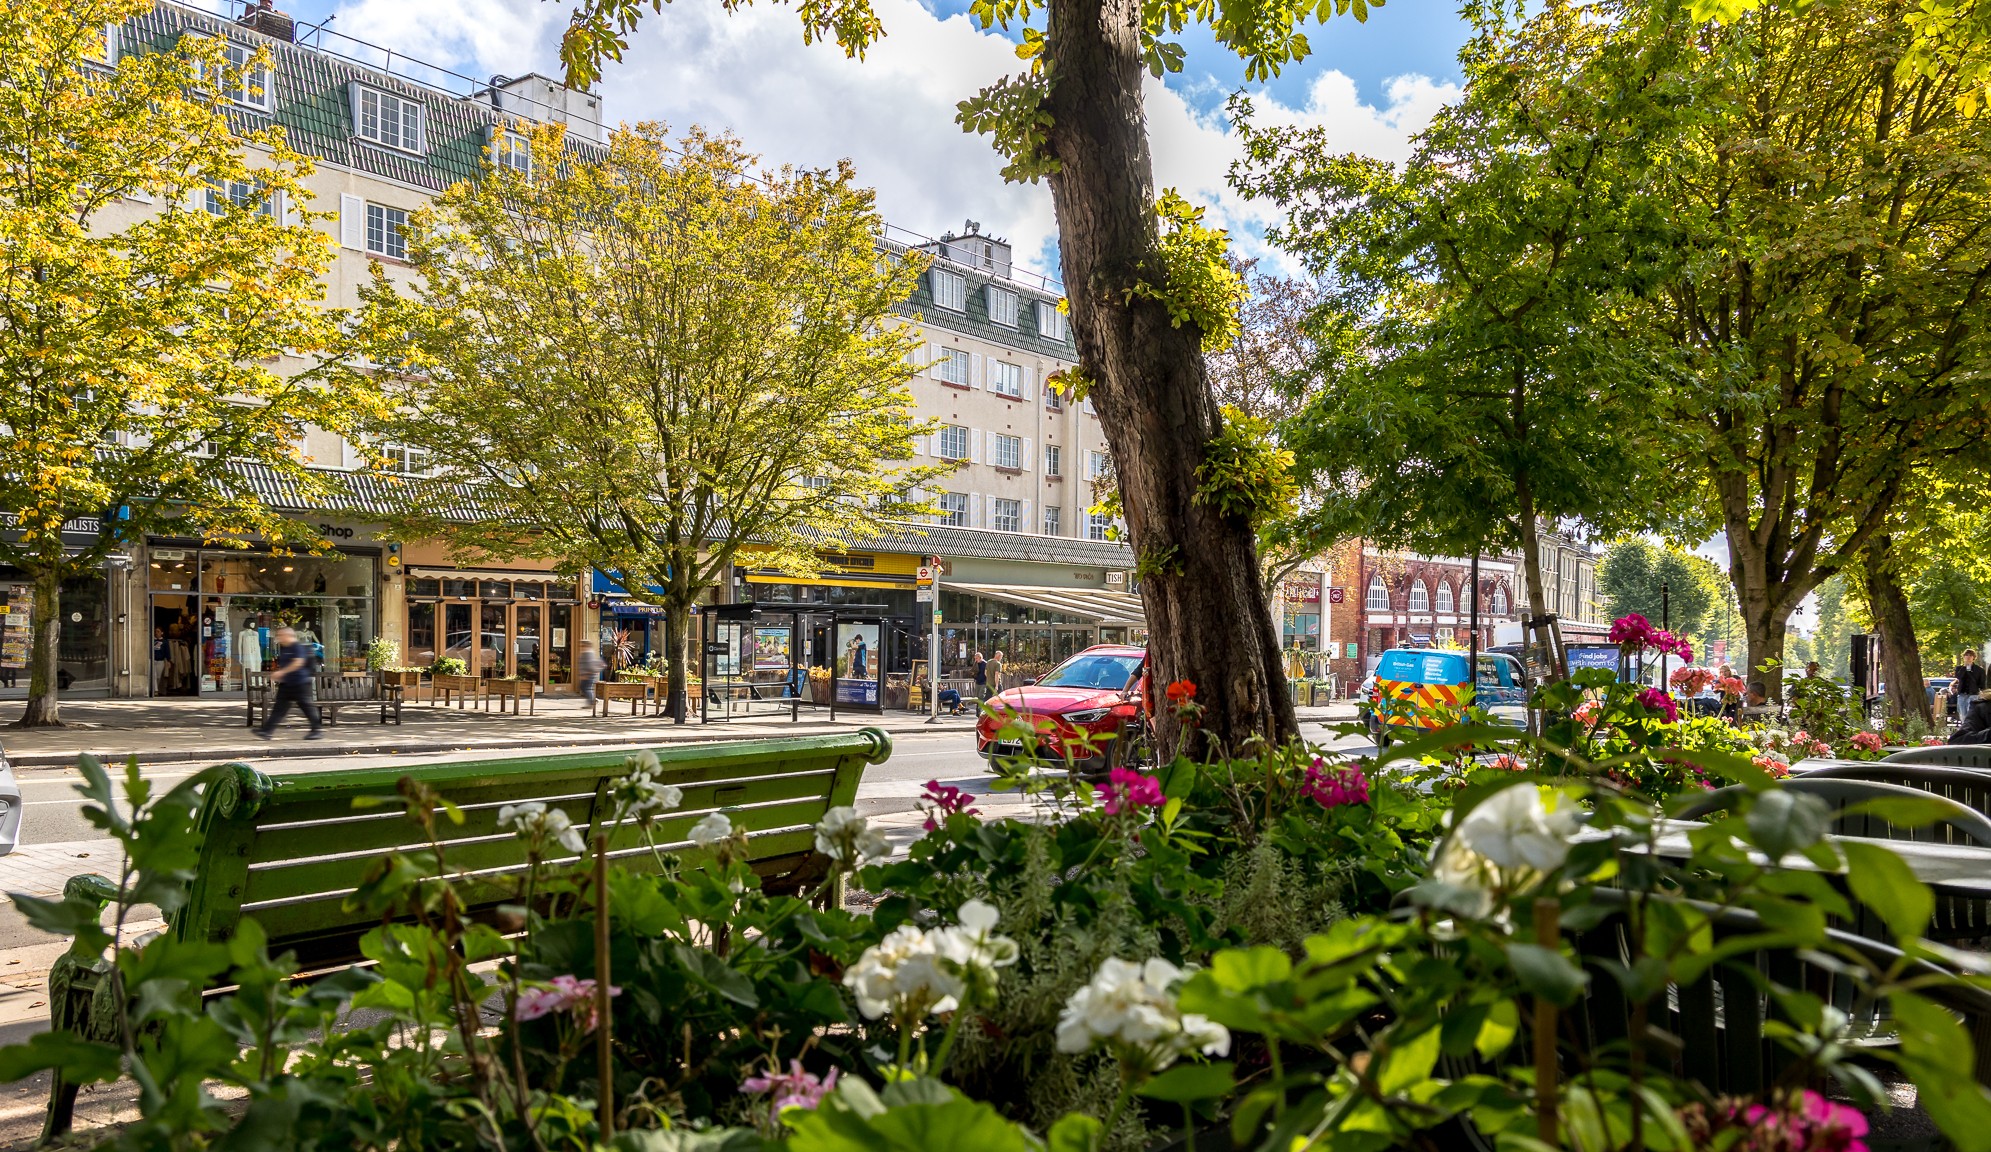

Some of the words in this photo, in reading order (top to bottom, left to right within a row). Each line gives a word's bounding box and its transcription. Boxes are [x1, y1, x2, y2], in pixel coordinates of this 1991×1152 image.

[60, 519, 99, 531] IALISTS
[319, 523, 353, 540] Shop
[1107, 573, 1122, 583] TISH
